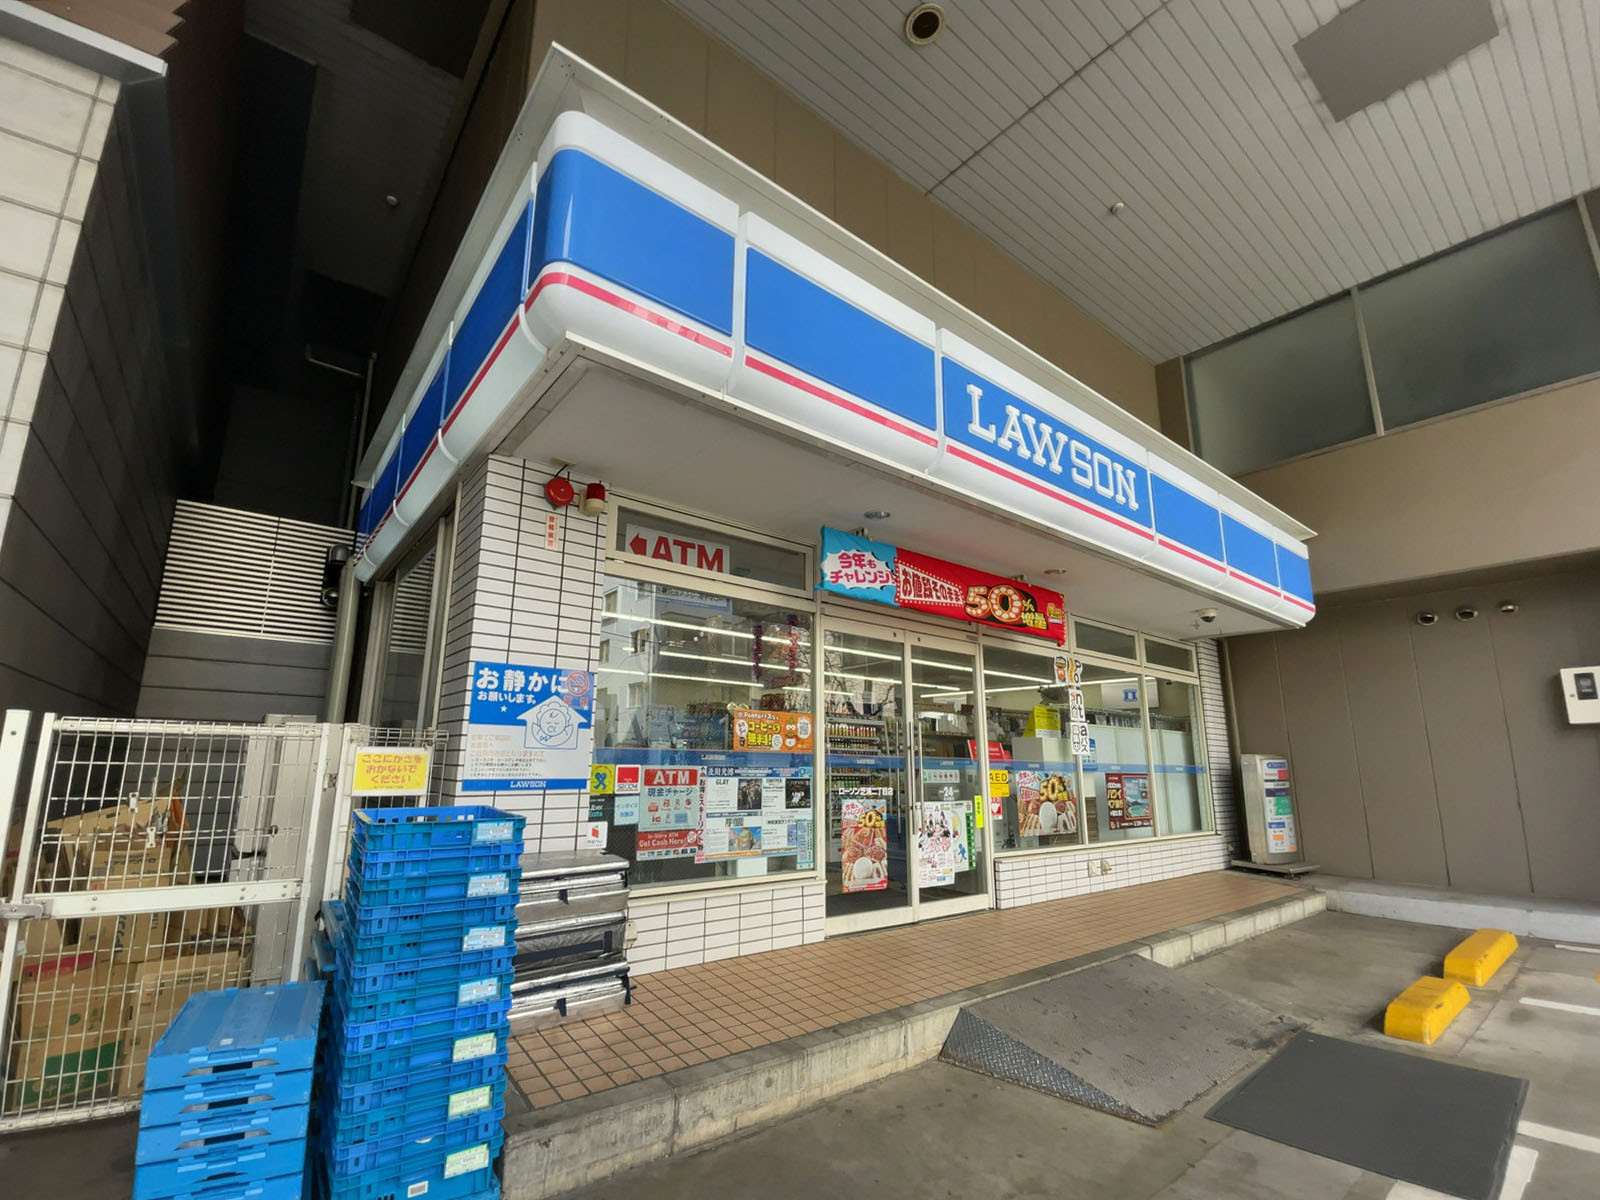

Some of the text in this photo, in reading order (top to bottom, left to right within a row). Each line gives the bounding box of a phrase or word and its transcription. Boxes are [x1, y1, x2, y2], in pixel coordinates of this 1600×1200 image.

[966, 383, 1139, 511] LAWSON
[651, 535, 724, 573] ATM
[838, 552, 877, 569] 今年も
[476, 667, 568, 693] お静かに
[477, 691, 537, 704] お願いします。
[366, 765, 416, 774] おかないで
[371, 775, 411, 784] ください
[653, 770, 690, 785] ATM
[989, 772, 1009, 782] AED
[647, 787, 693, 797] 現金チャージ
[651, 838, 668, 846] Cash
